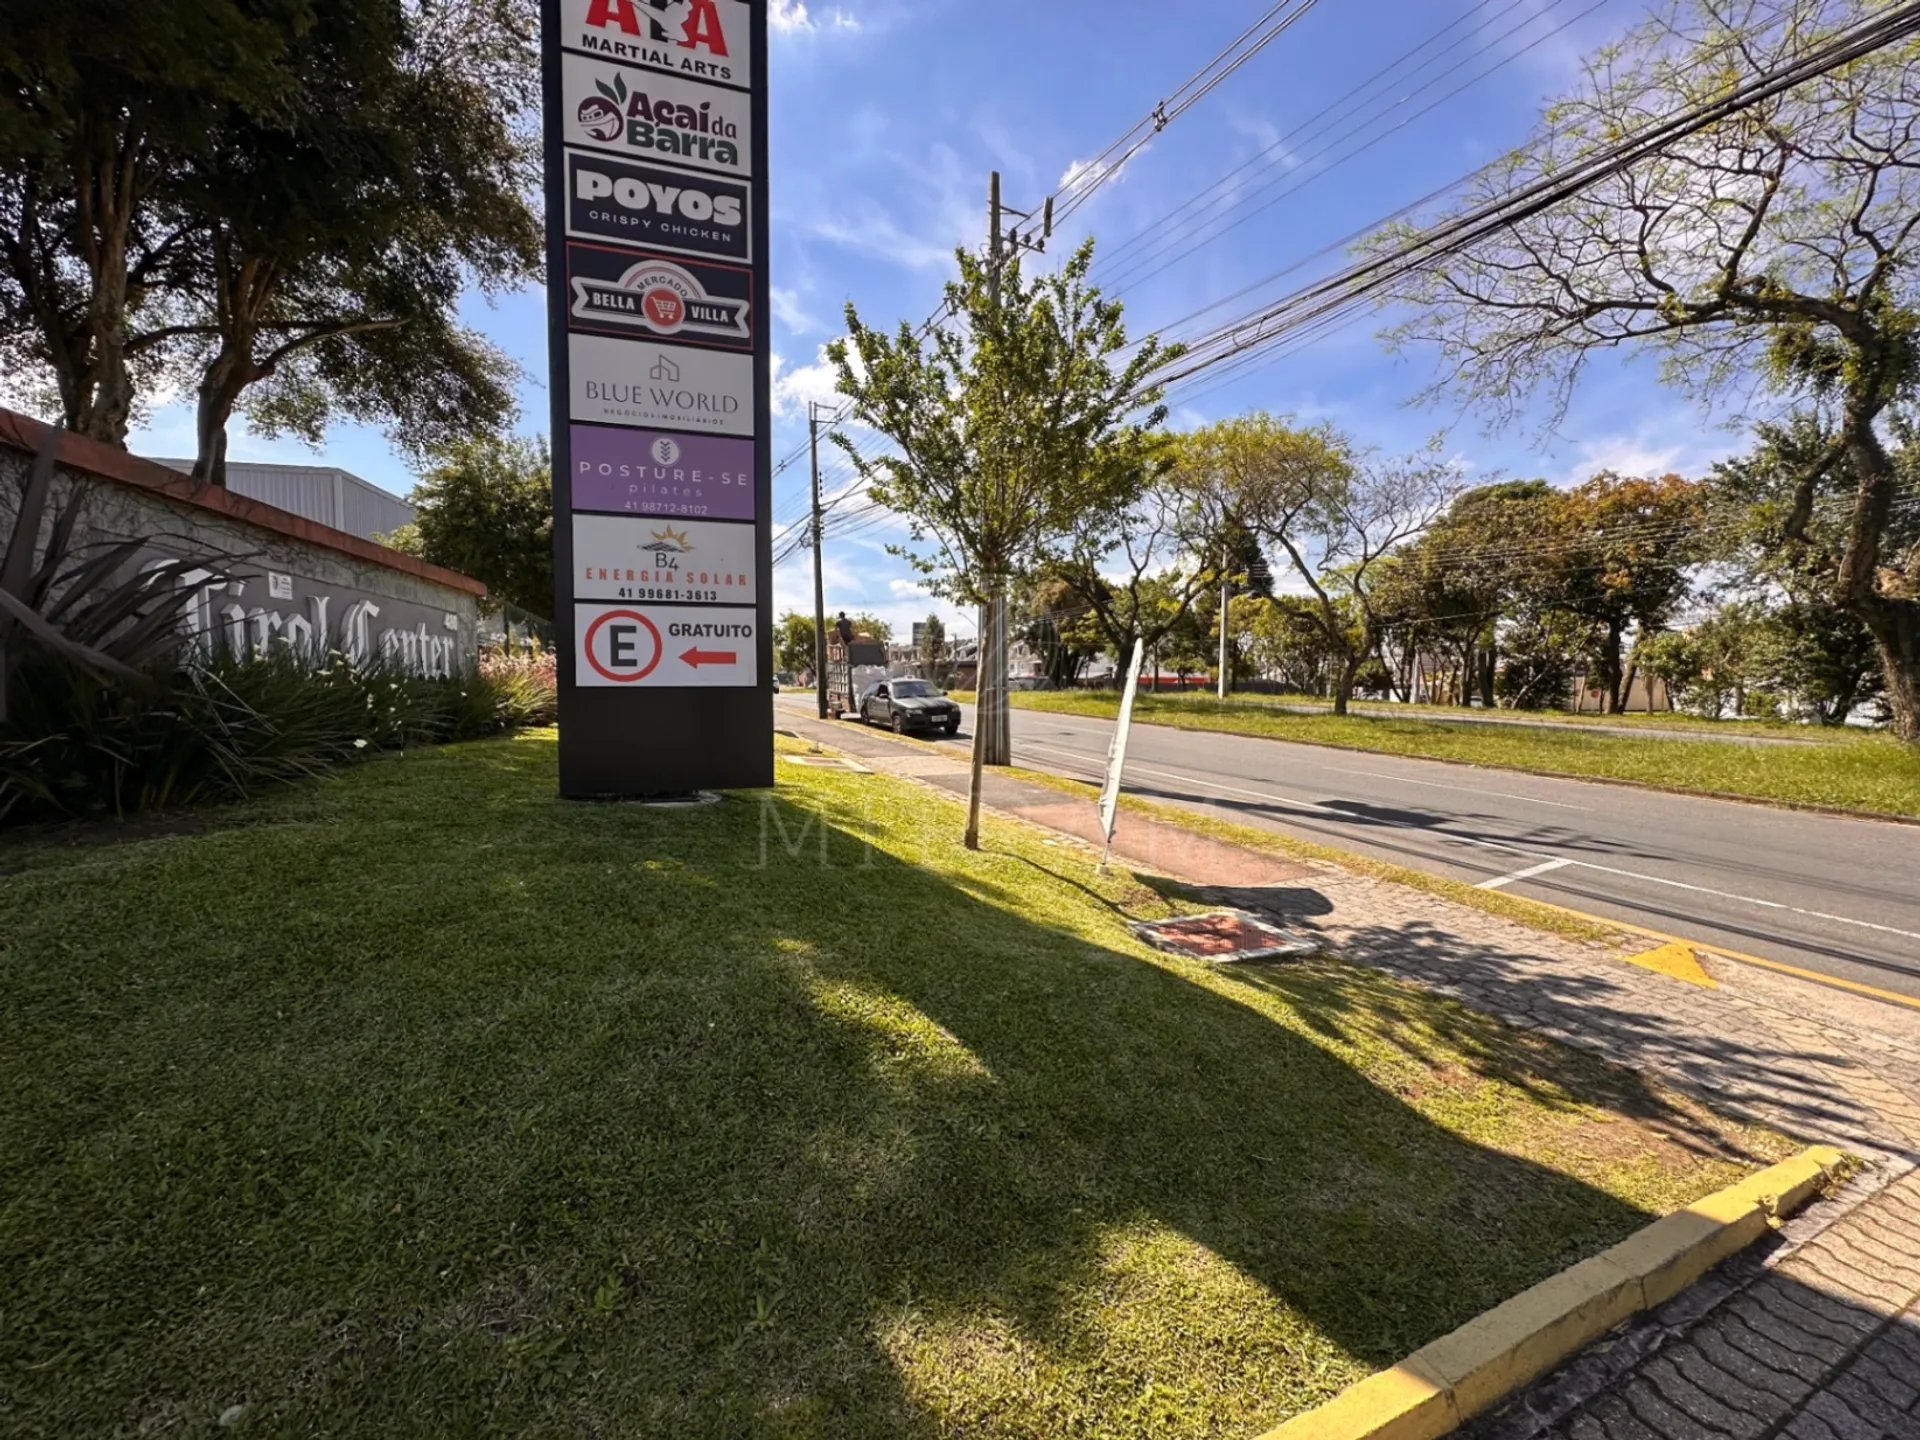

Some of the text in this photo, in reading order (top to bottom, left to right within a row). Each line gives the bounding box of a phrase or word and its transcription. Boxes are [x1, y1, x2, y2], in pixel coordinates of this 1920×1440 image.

[582, 34, 732, 80] MARTIAL ARTS
[711, 115, 737, 139] da
[626, 119, 739, 166] Barra
[576, 168, 742, 227] POYOS
[589, 210, 732, 243] CRISPY CHICKEN
[636, 275, 688, 299] MERCADO
[592, 292, 729, 323] BELLA VILLA
[586, 380, 738, 414] BLUE WORLD
[579, 461, 748, 487] POSTURE-SE
[628, 484, 703, 498] pilates
[624, 501, 708, 515] 41 98712-8102
[655, 552, 679, 572] B4
[586, 567, 747, 586] ENERGIA SOLAR
[618, 587, 718, 601] 41 99681-3613
[668, 623, 752, 638] GRATUITO
[609, 624, 638, 668] E
